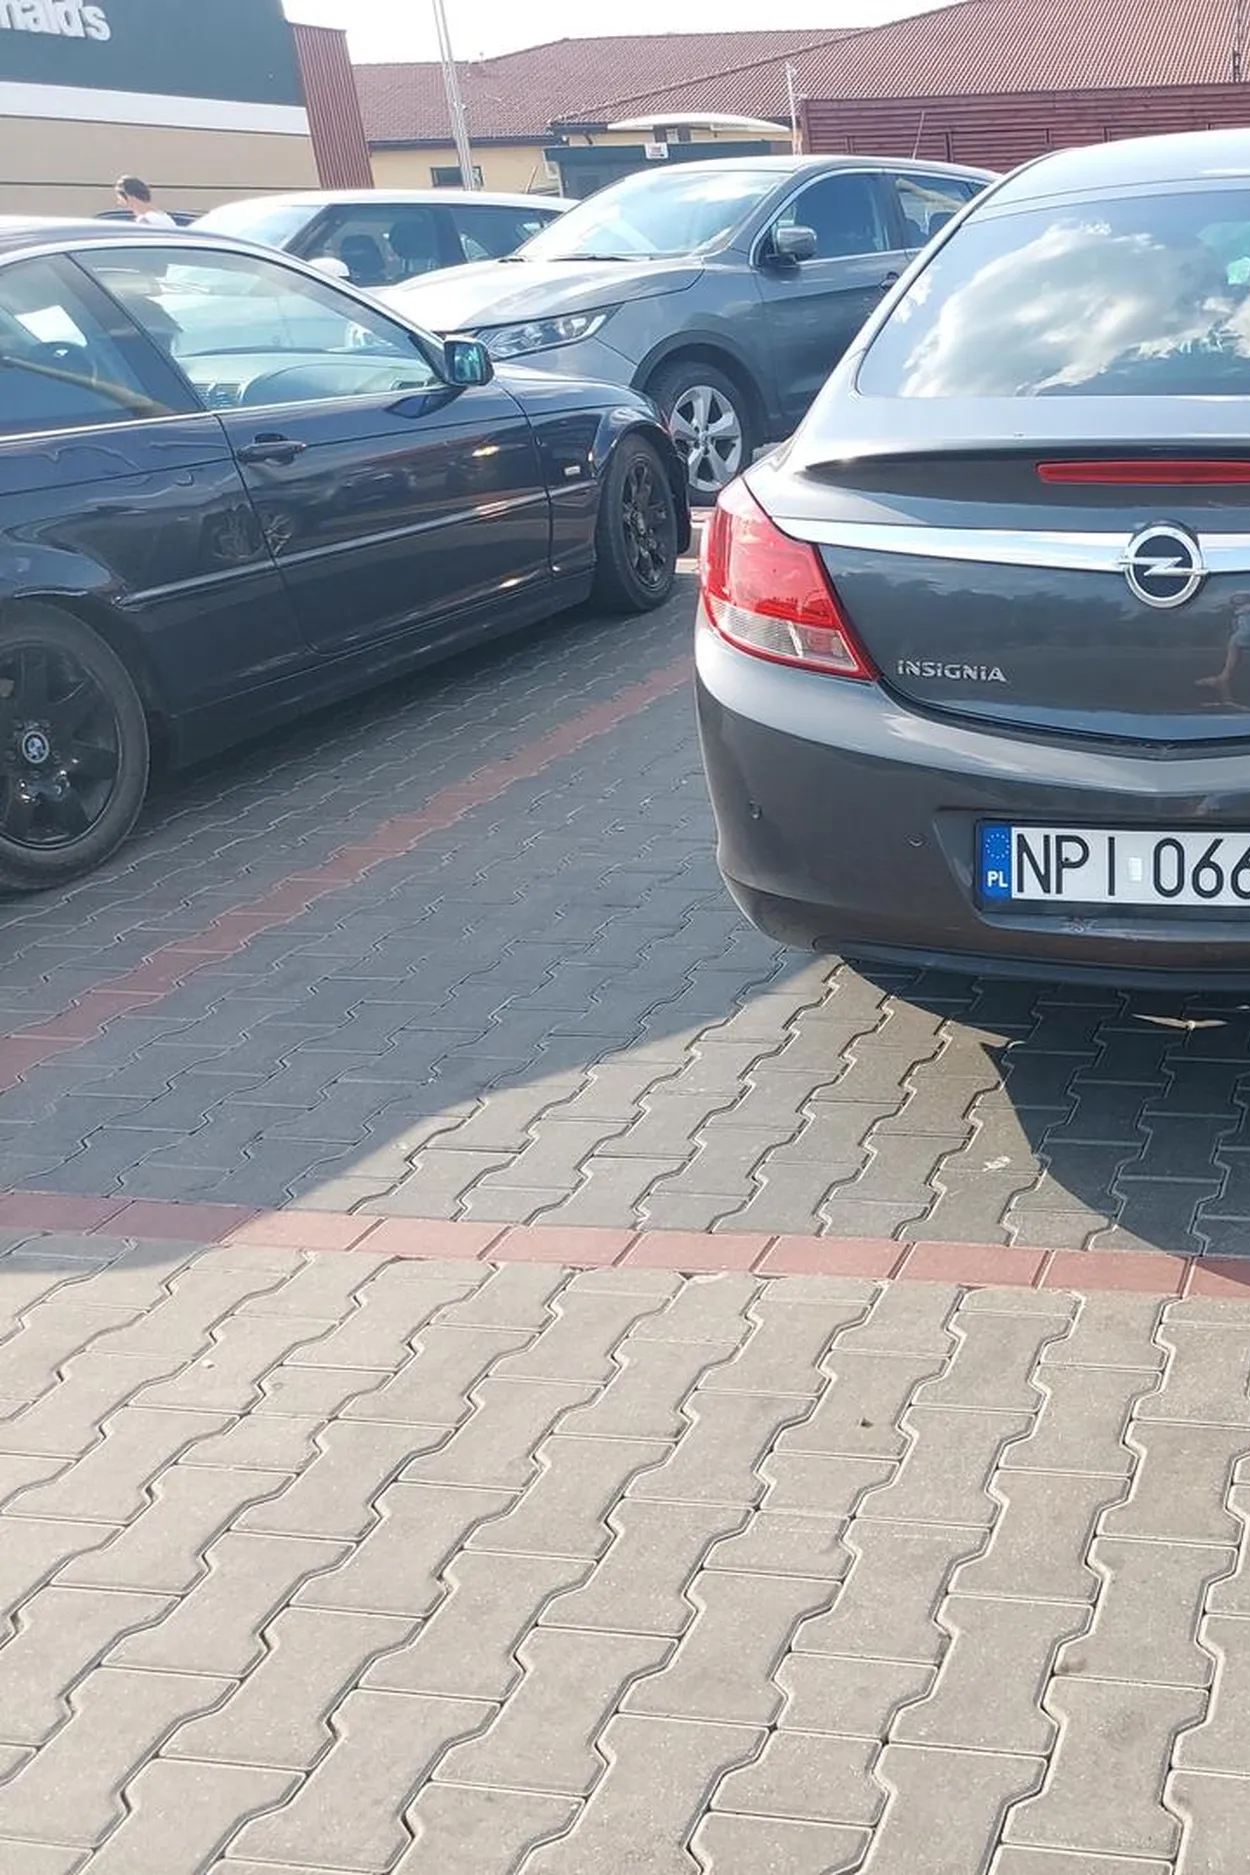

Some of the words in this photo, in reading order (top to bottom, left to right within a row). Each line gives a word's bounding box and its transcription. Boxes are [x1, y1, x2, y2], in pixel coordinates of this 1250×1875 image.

[898, 660, 1007, 682] INSIGNIA
[1016, 833, 1116, 896] NPI
[987, 871, 1009, 888] PL
